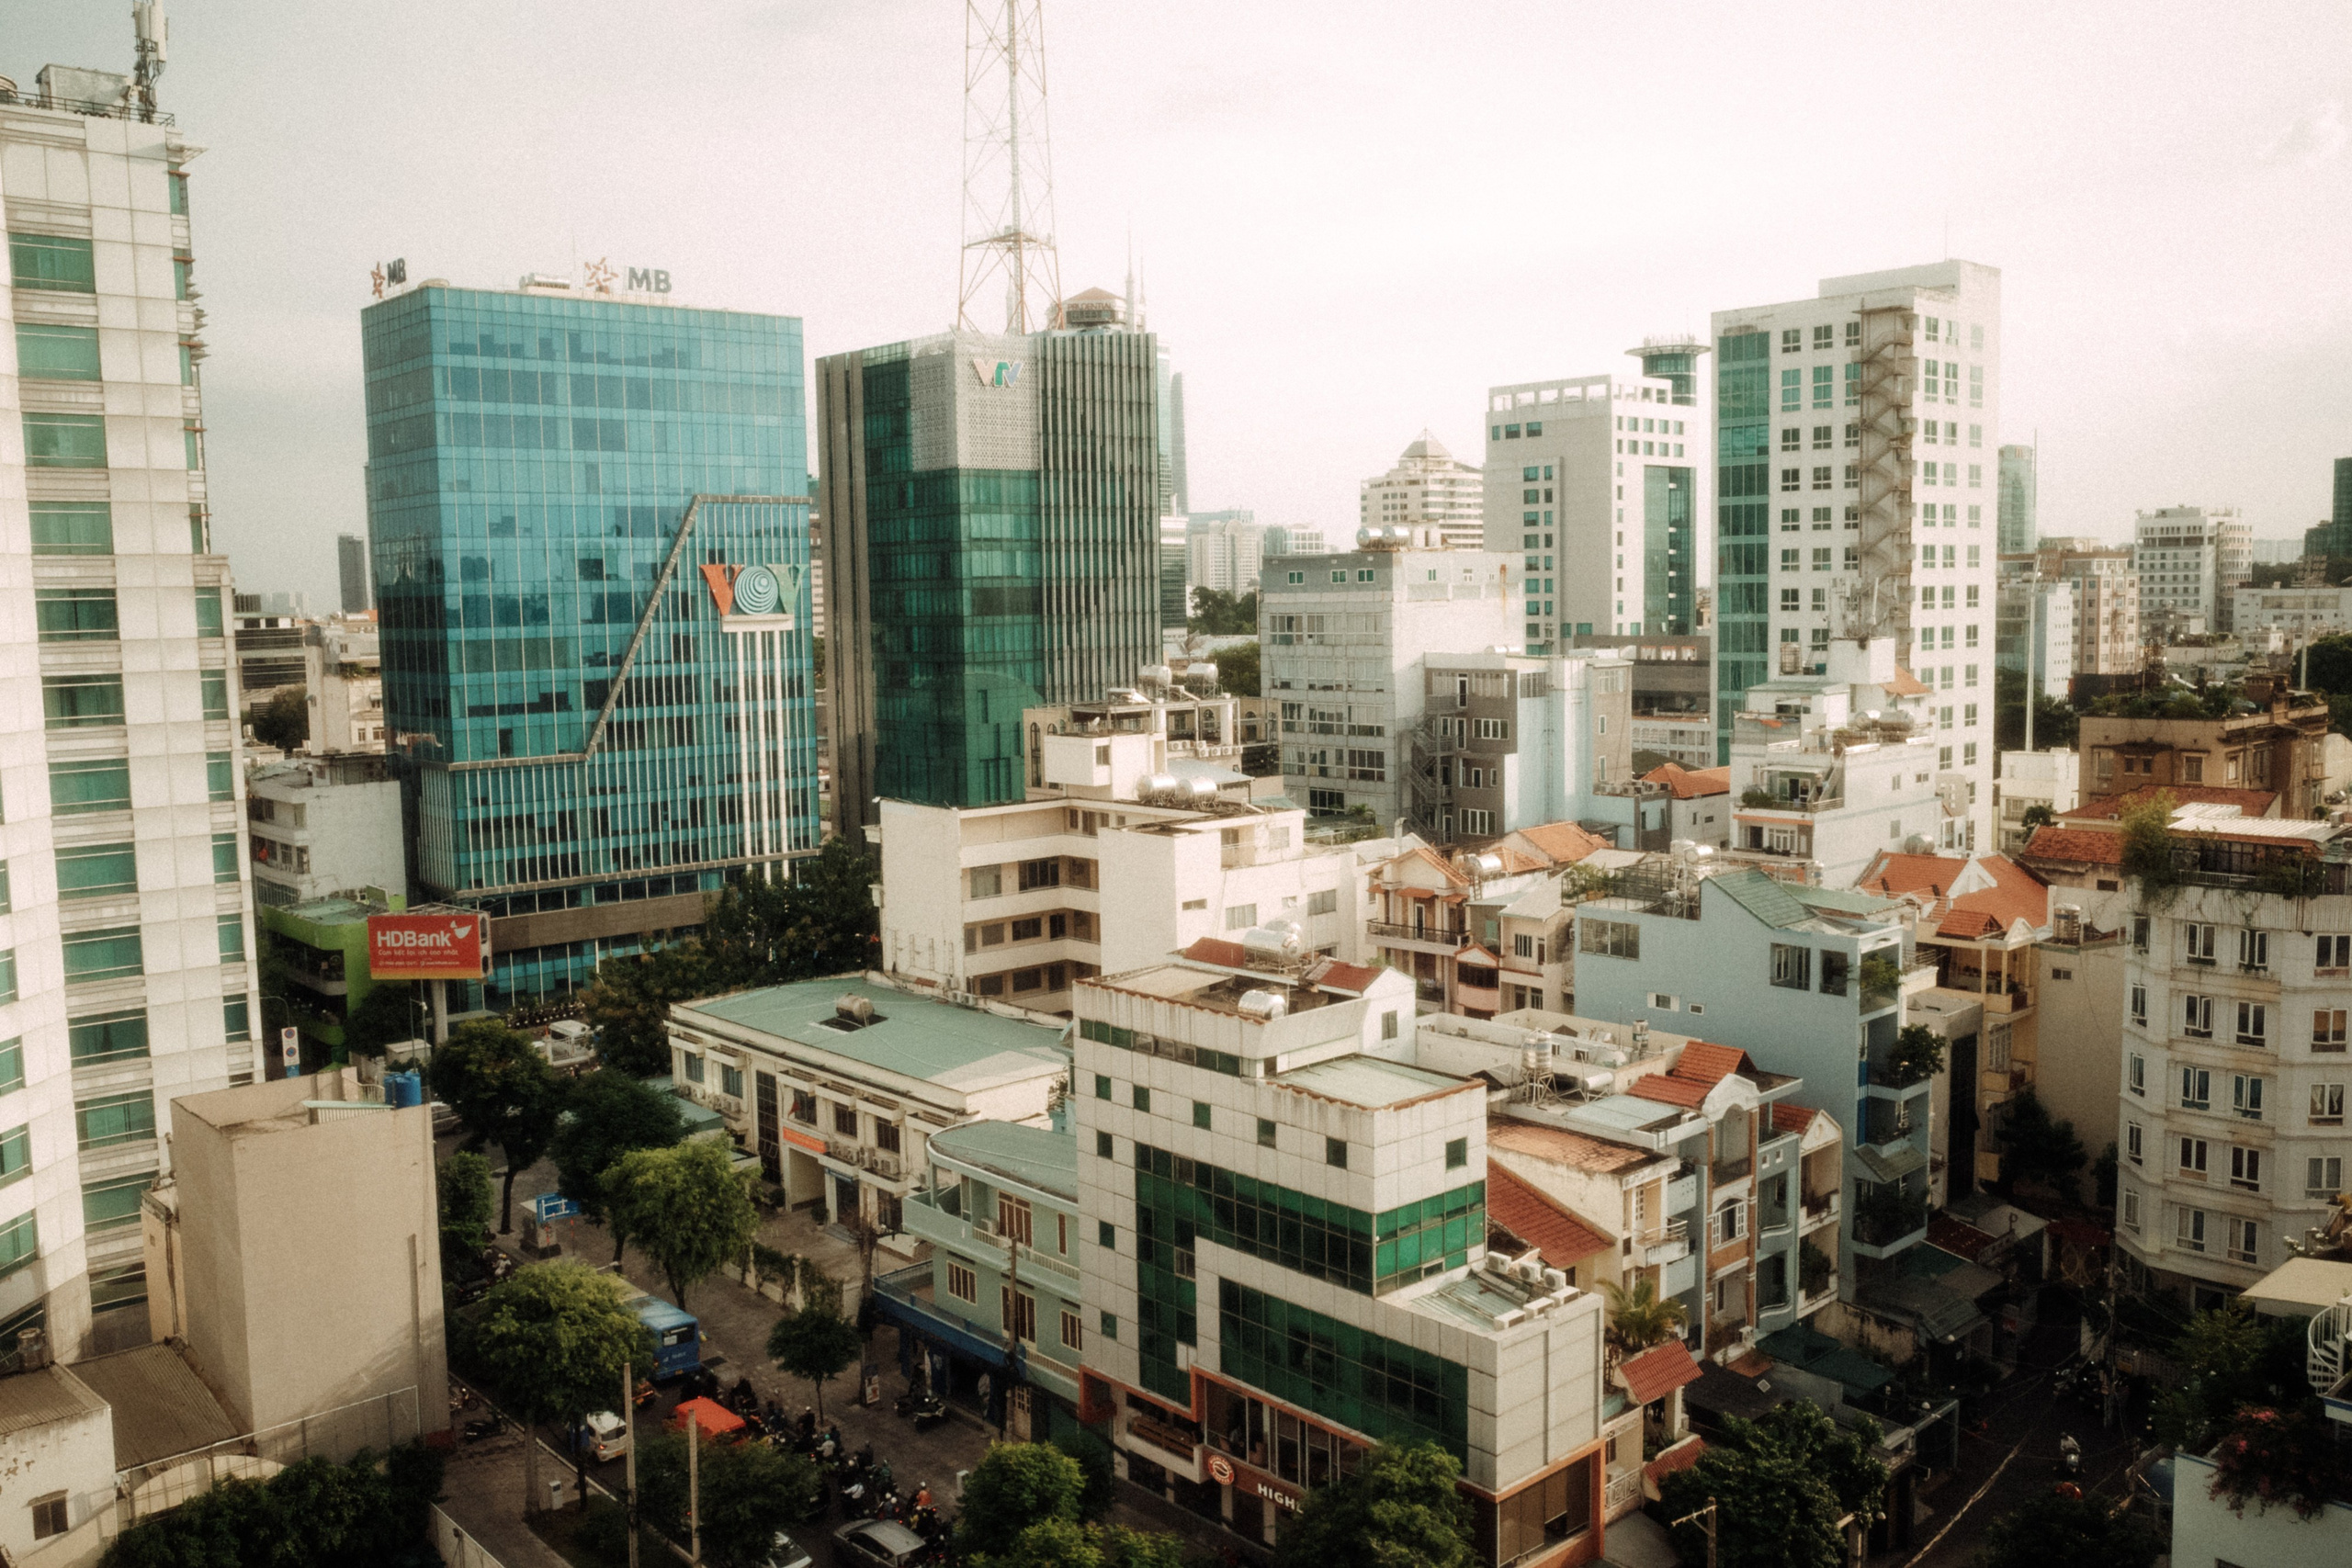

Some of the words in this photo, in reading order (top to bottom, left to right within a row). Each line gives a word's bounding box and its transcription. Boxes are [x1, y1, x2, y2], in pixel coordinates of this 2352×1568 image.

[387, 257, 406, 288] MB
[628, 266, 673, 293] MB
[377, 931, 451, 947] HDBank
